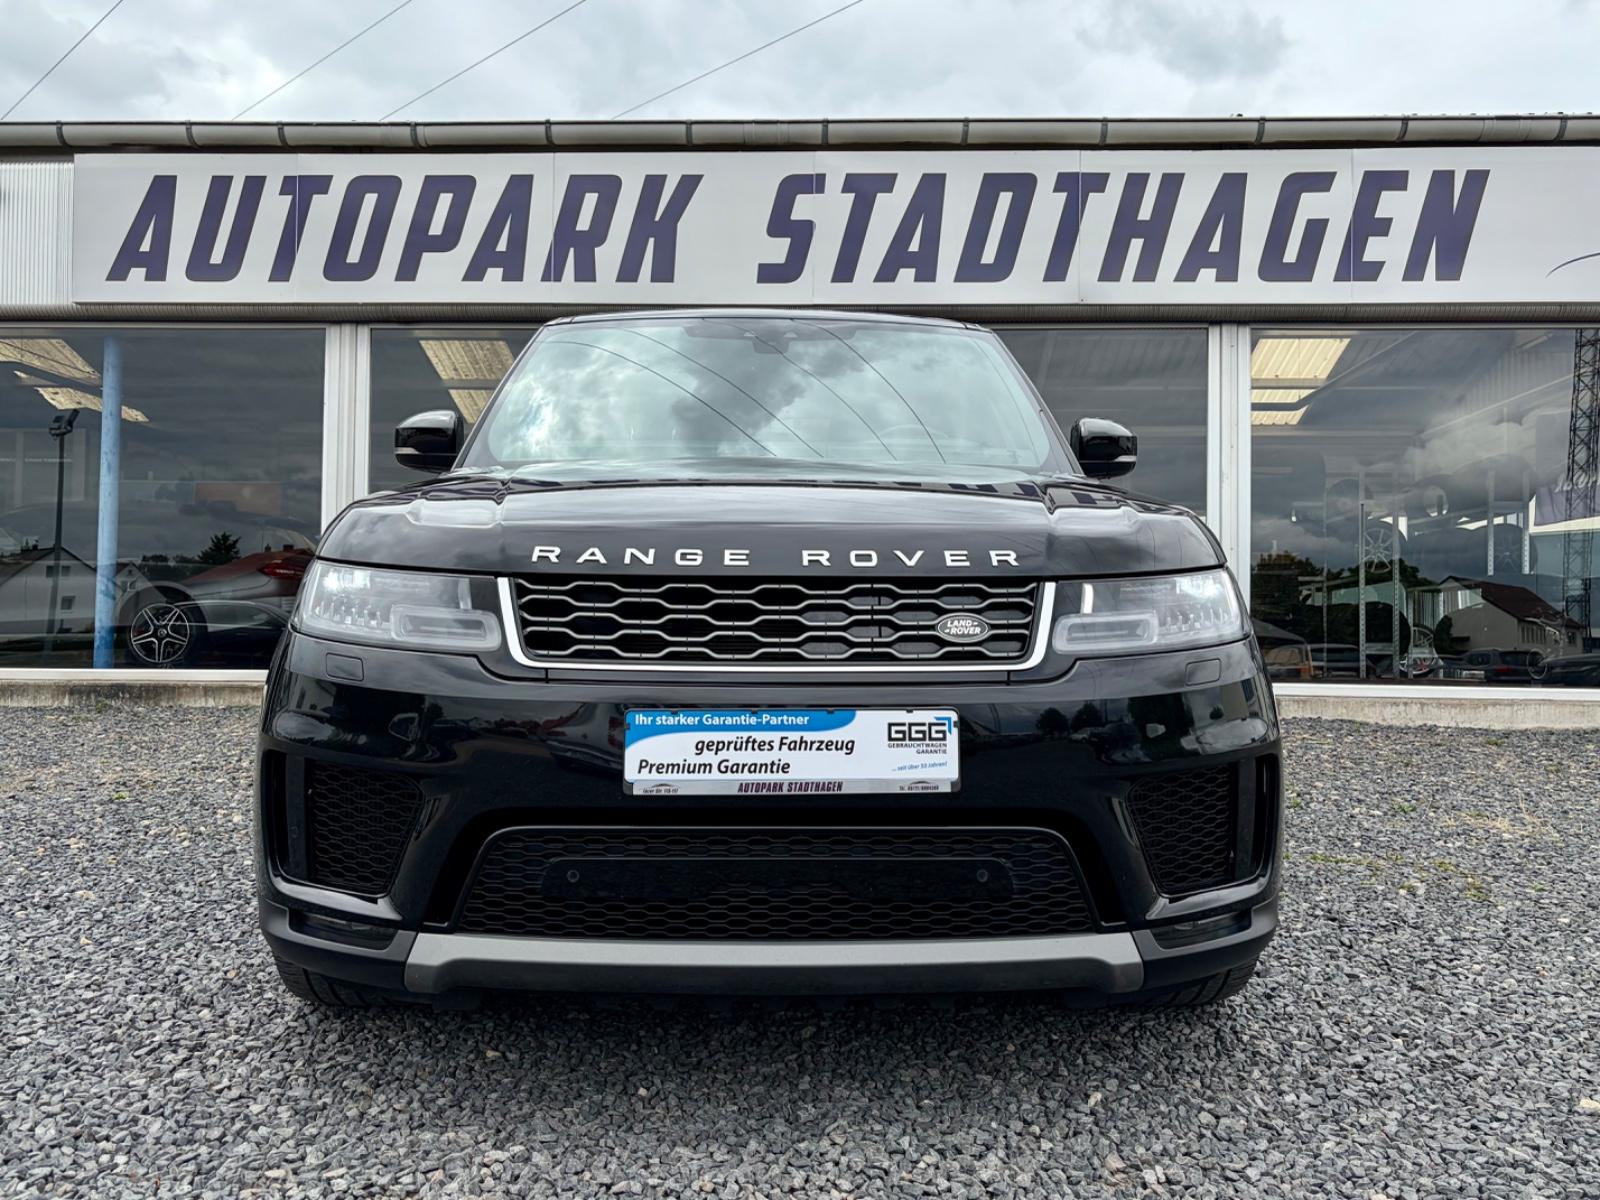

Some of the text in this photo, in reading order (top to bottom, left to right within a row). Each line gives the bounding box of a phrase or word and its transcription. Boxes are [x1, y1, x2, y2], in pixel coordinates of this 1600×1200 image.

[106, 170, 1490, 283] AUTOPARK STADTHAGEN
[531, 546, 1021, 567] RANGE ROVER
[947, 619, 972, 627] LAND
[950, 626, 981, 635] ROVER
[635, 714, 809, 725] Ihr starker Garantie-Partner
[887, 723, 947, 742] GGG
[695, 736, 855, 755] geprüftes Fahrzeug
[638, 759, 790, 774] Premium Garantie
[738, 781, 843, 793] AUTOPARK STADTHAGEN
